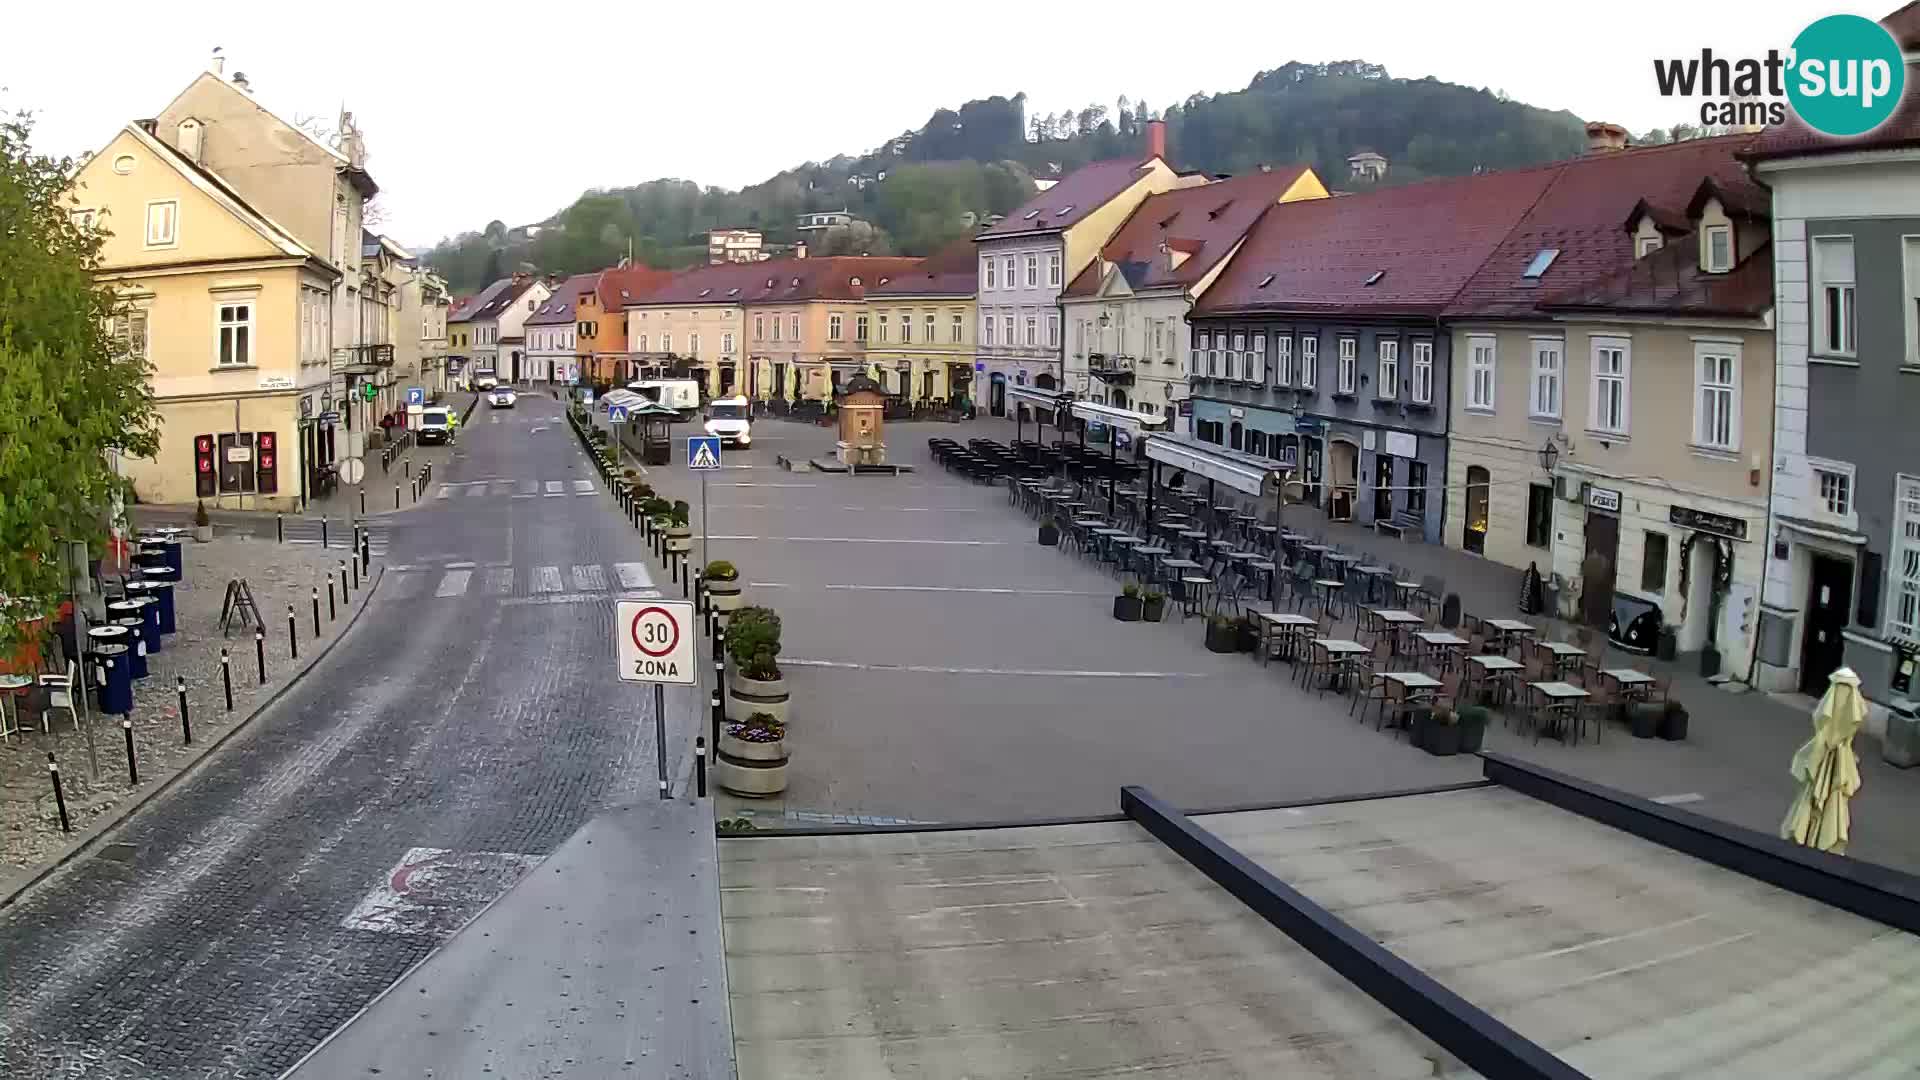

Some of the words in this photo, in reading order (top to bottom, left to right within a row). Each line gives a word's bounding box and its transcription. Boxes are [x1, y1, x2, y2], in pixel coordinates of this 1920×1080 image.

[411, 391, 420, 403] P
[644, 622, 668, 644] 30
[634, 660, 679, 677] ZONA
